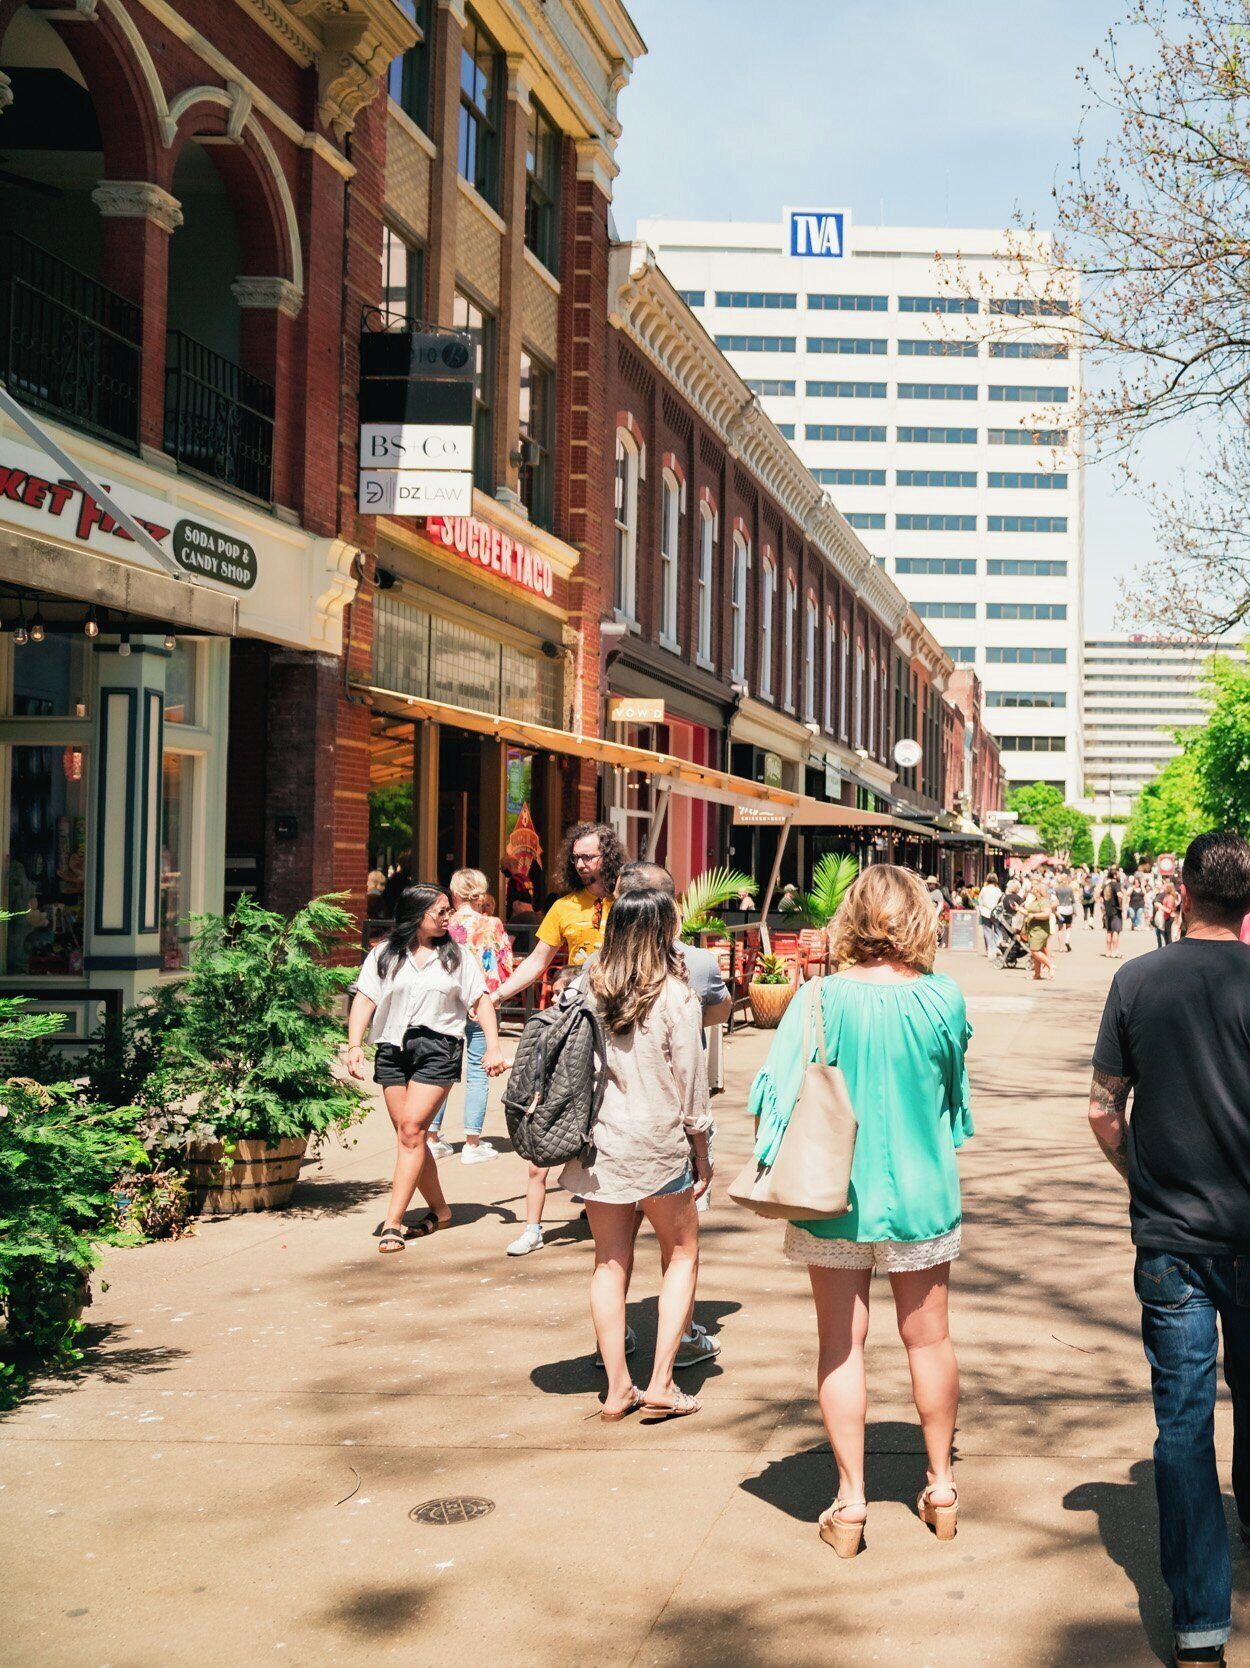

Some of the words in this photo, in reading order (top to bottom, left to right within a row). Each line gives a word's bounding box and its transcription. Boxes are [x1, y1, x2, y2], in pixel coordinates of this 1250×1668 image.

[793, 215, 841, 254] TVA
[399, 487, 421, 500] DZ
[424, 487, 463, 501] LAW
[184, 525, 215, 551] SODA
[217, 538, 240, 560] POP
[242, 550, 250, 564] &
[440, 516, 512, 576] SOCCER
[514, 542, 553, 598] TACO
[181, 547, 219, 572] CANDY
[220, 560, 251, 584] SHOP
